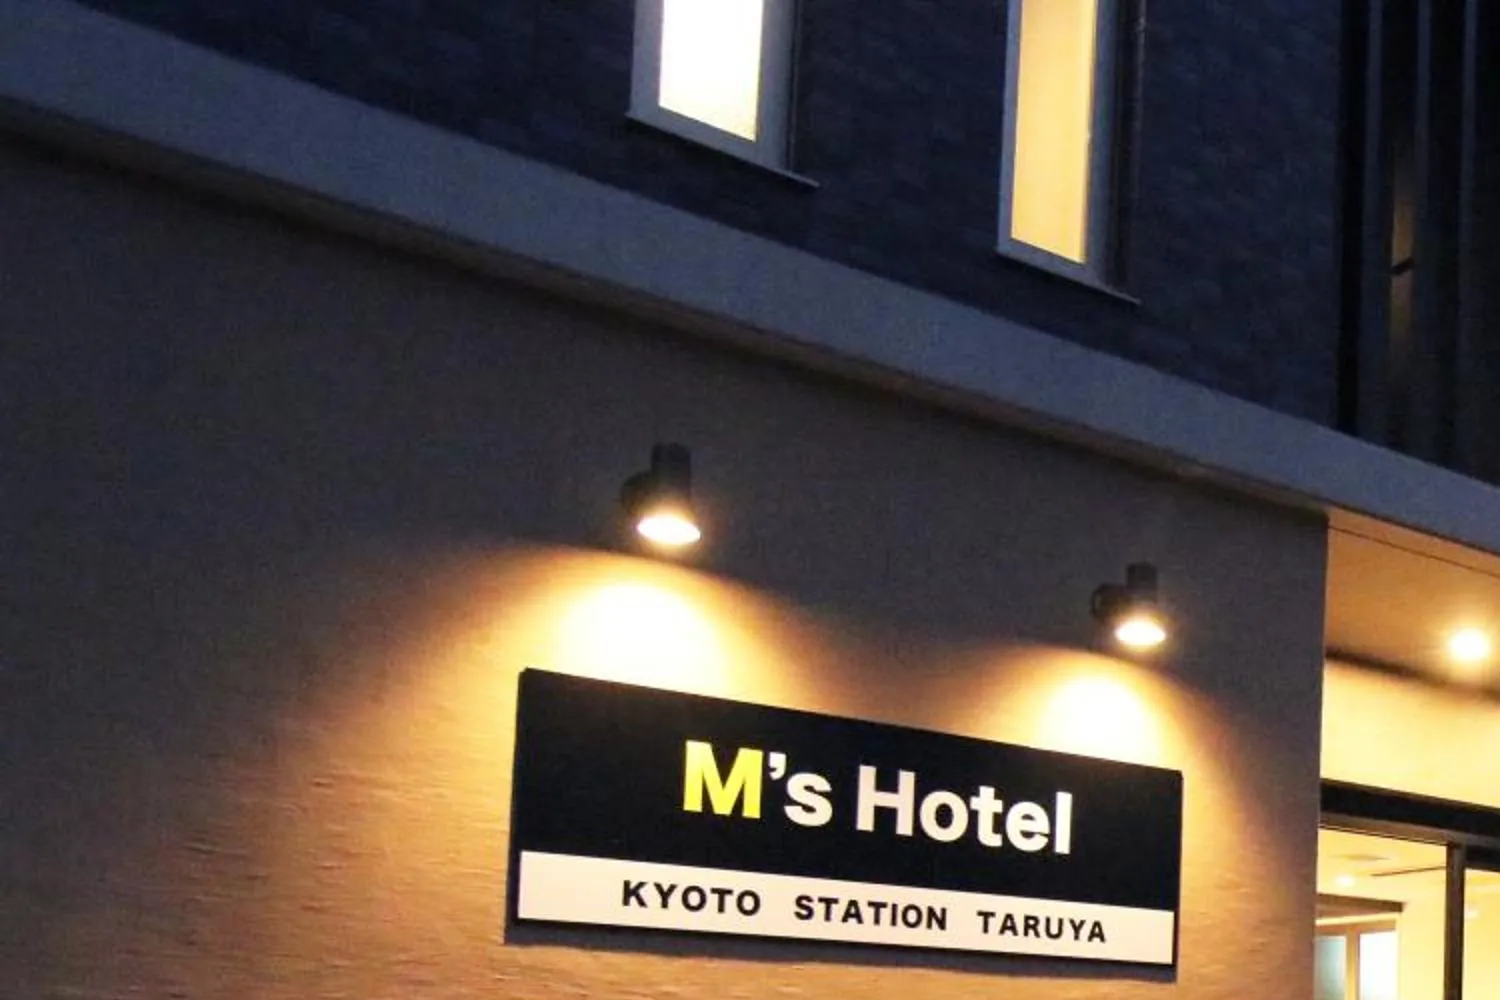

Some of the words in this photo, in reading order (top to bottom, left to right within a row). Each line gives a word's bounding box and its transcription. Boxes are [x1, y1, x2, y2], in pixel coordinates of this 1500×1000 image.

[682, 739, 833, 827] M's
[855, 764, 1073, 855] Hotel
[622, 880, 761, 917] KYOTO
[794, 895, 947, 931] STATION
[977, 910, 1106, 943] TARUYA
